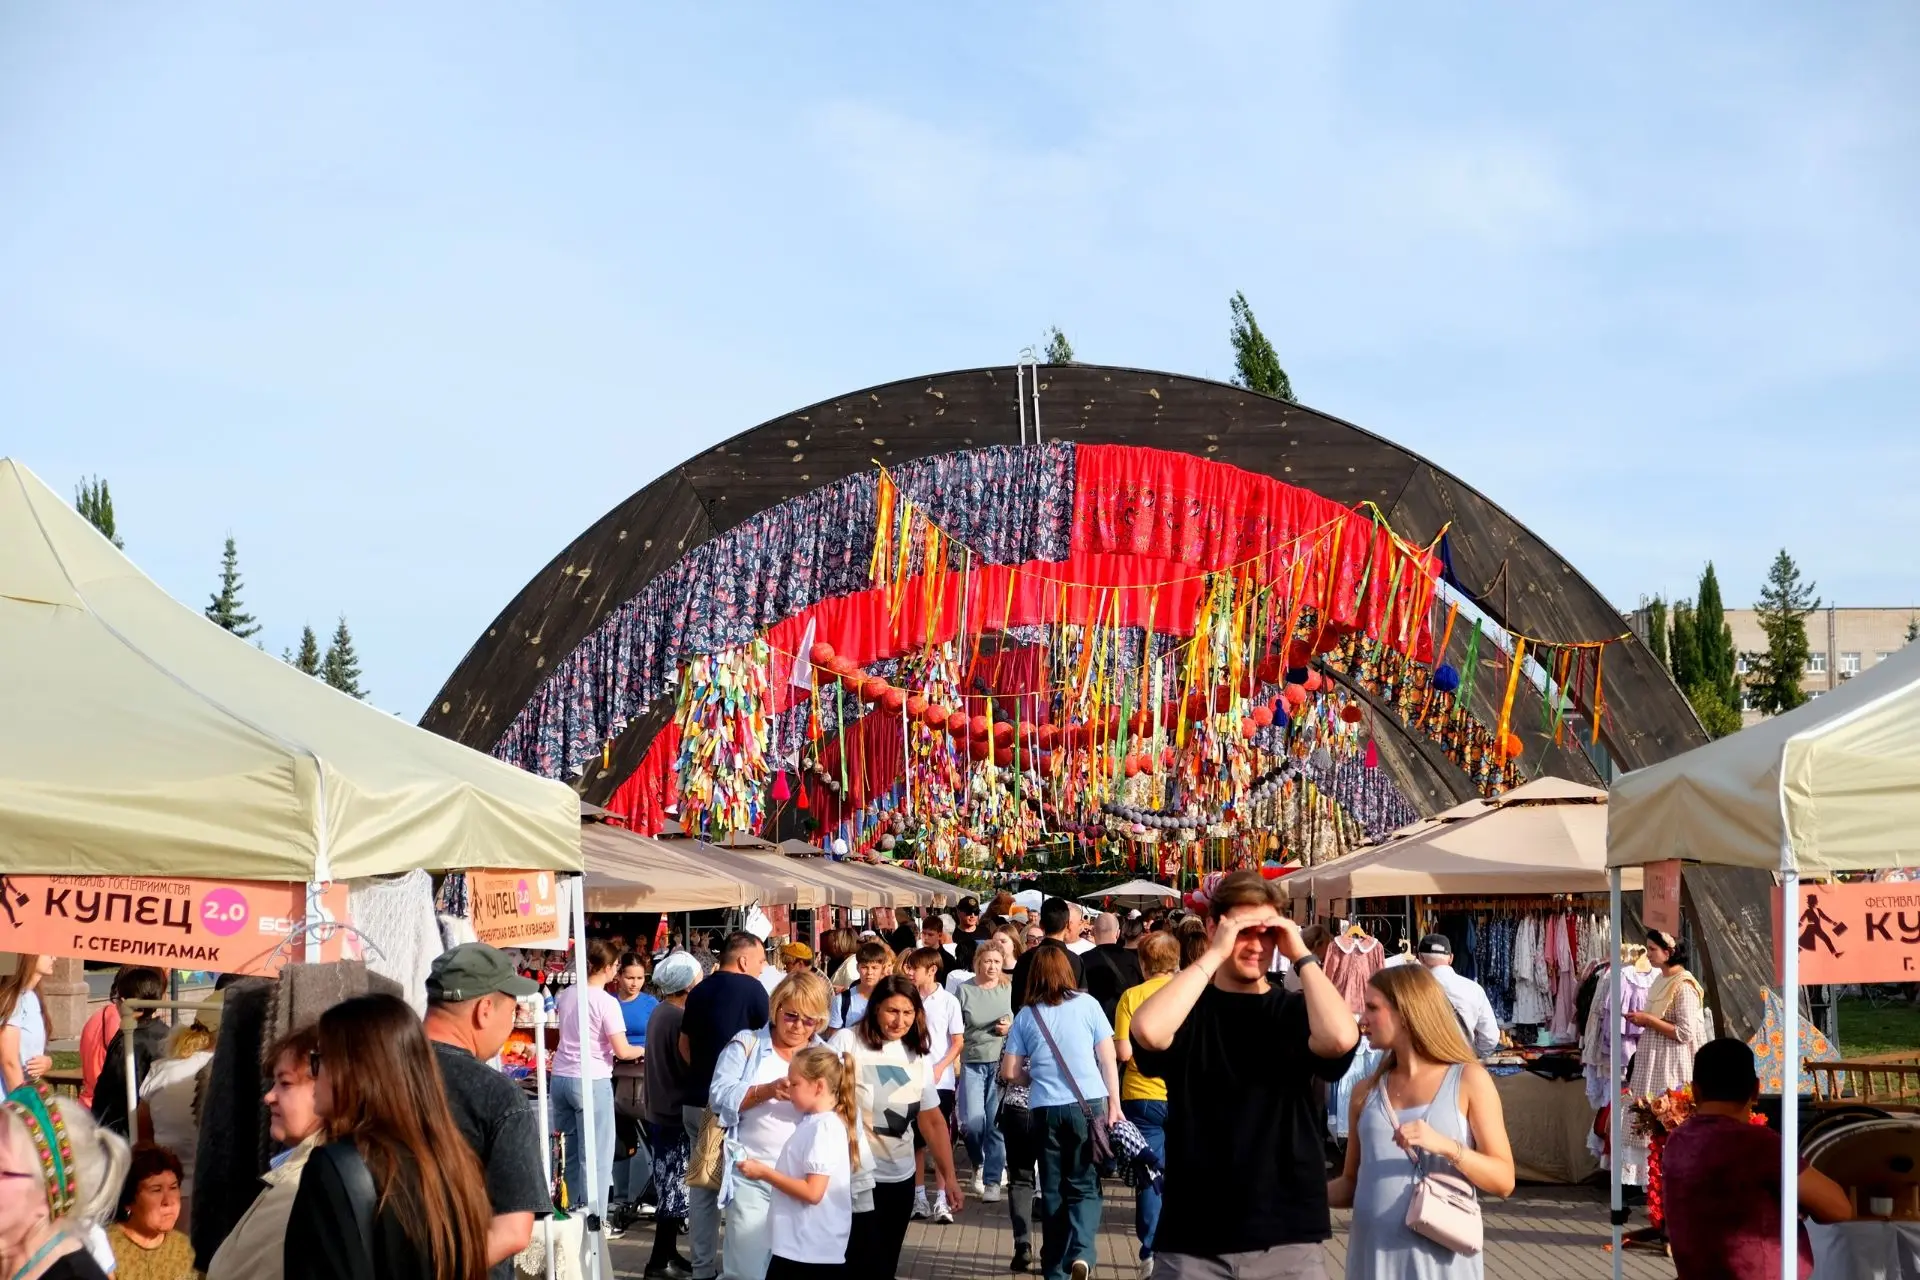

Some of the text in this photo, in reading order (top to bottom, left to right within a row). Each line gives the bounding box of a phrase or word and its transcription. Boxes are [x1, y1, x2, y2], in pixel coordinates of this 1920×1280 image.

[108, 877, 191, 896] ГОСТЕПРИИМСТВА
[45, 887, 192, 934] КУПЕЦ
[203, 901, 245, 921] 2.0
[485, 891, 518, 919] КУПЕЦ
[73, 935, 220, 962] Г. СТЕРЛИТАМАК
[1903, 957, 1914, 971] Г.
